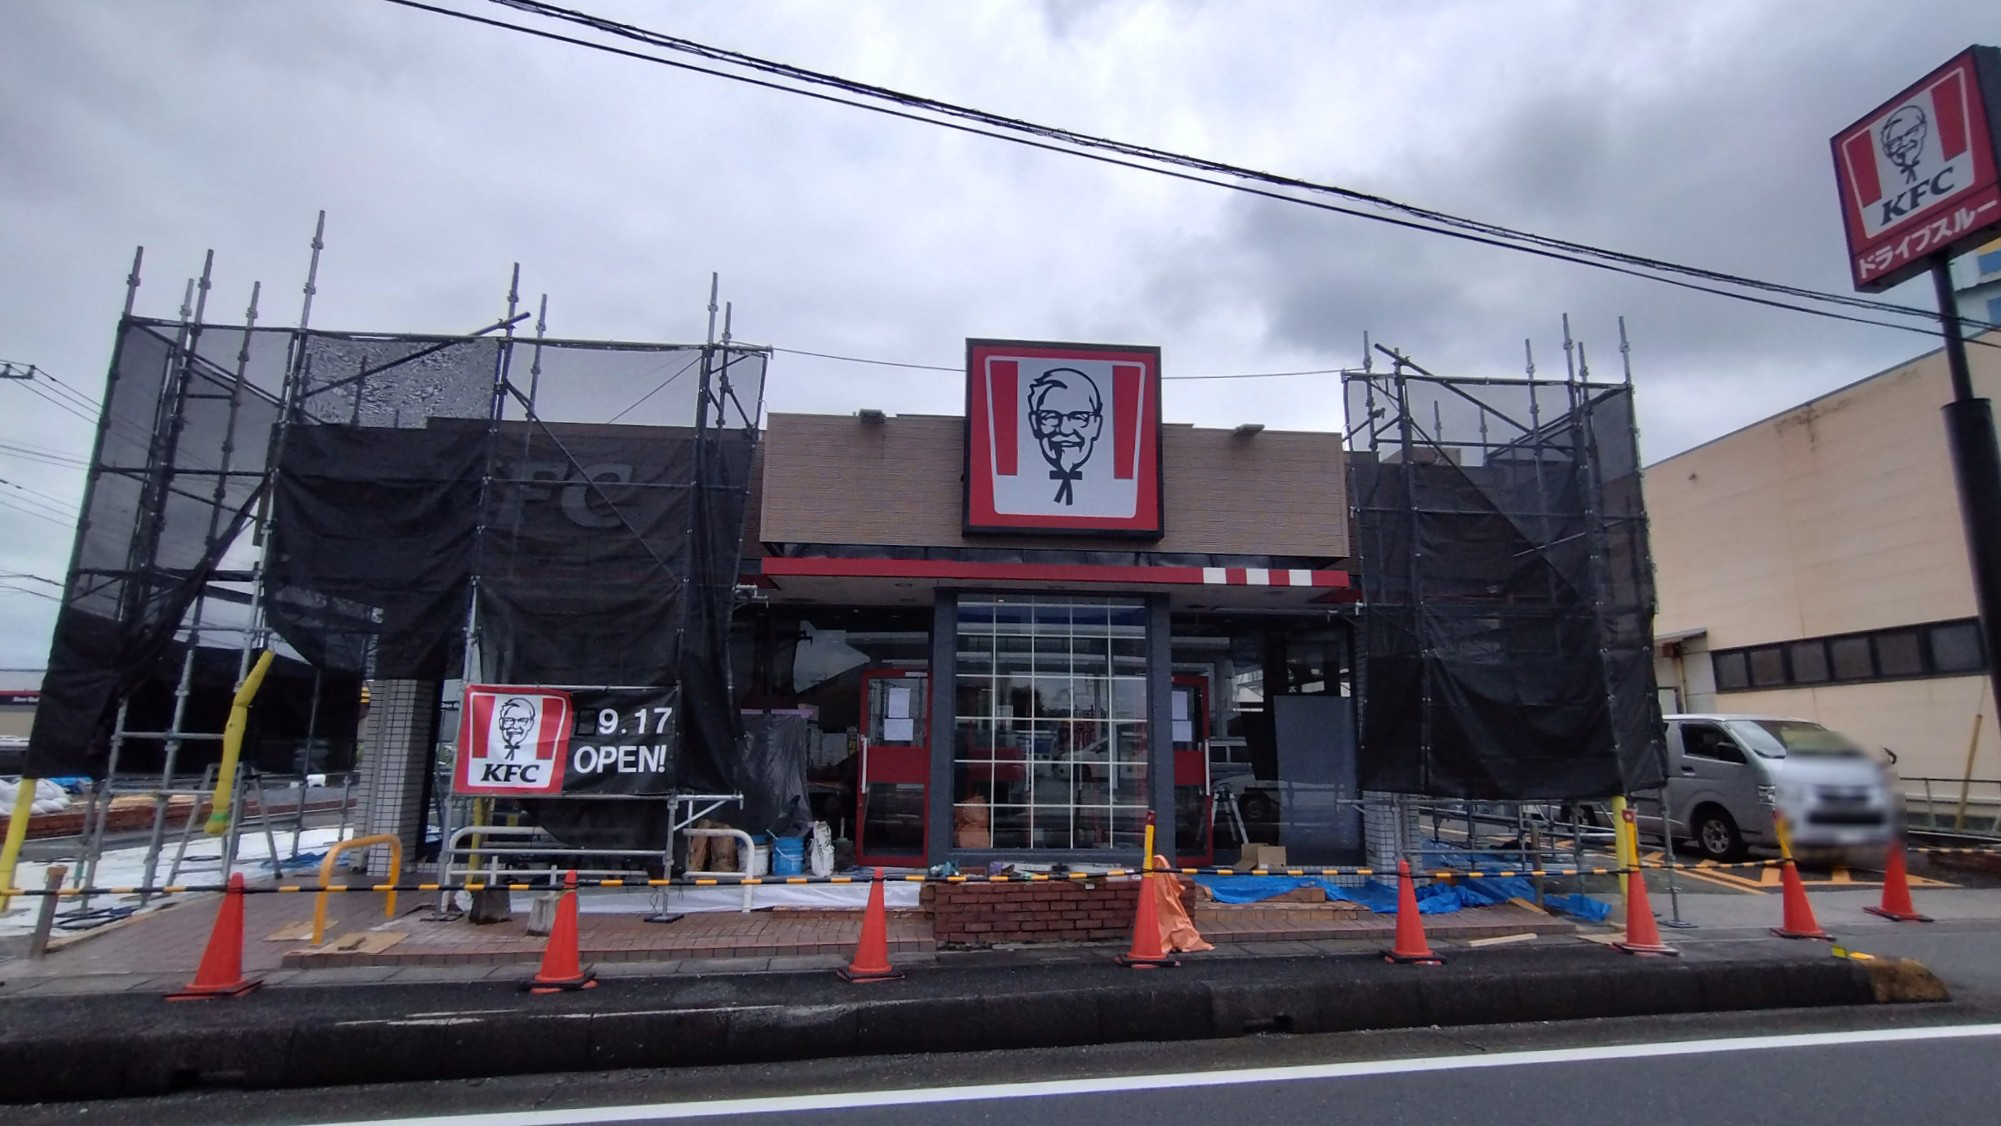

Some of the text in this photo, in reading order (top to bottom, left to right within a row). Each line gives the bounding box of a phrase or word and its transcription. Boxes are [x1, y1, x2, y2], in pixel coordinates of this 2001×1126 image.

[1880, 166, 1955, 226] KFC
[1859, 199, 1998, 279] ドライブスルー
[494, 462, 635, 529] FC
[598, 707, 672, 734] 9.17
[480, 763, 540, 783] KFC
[573, 744, 667, 774] OPEN!
